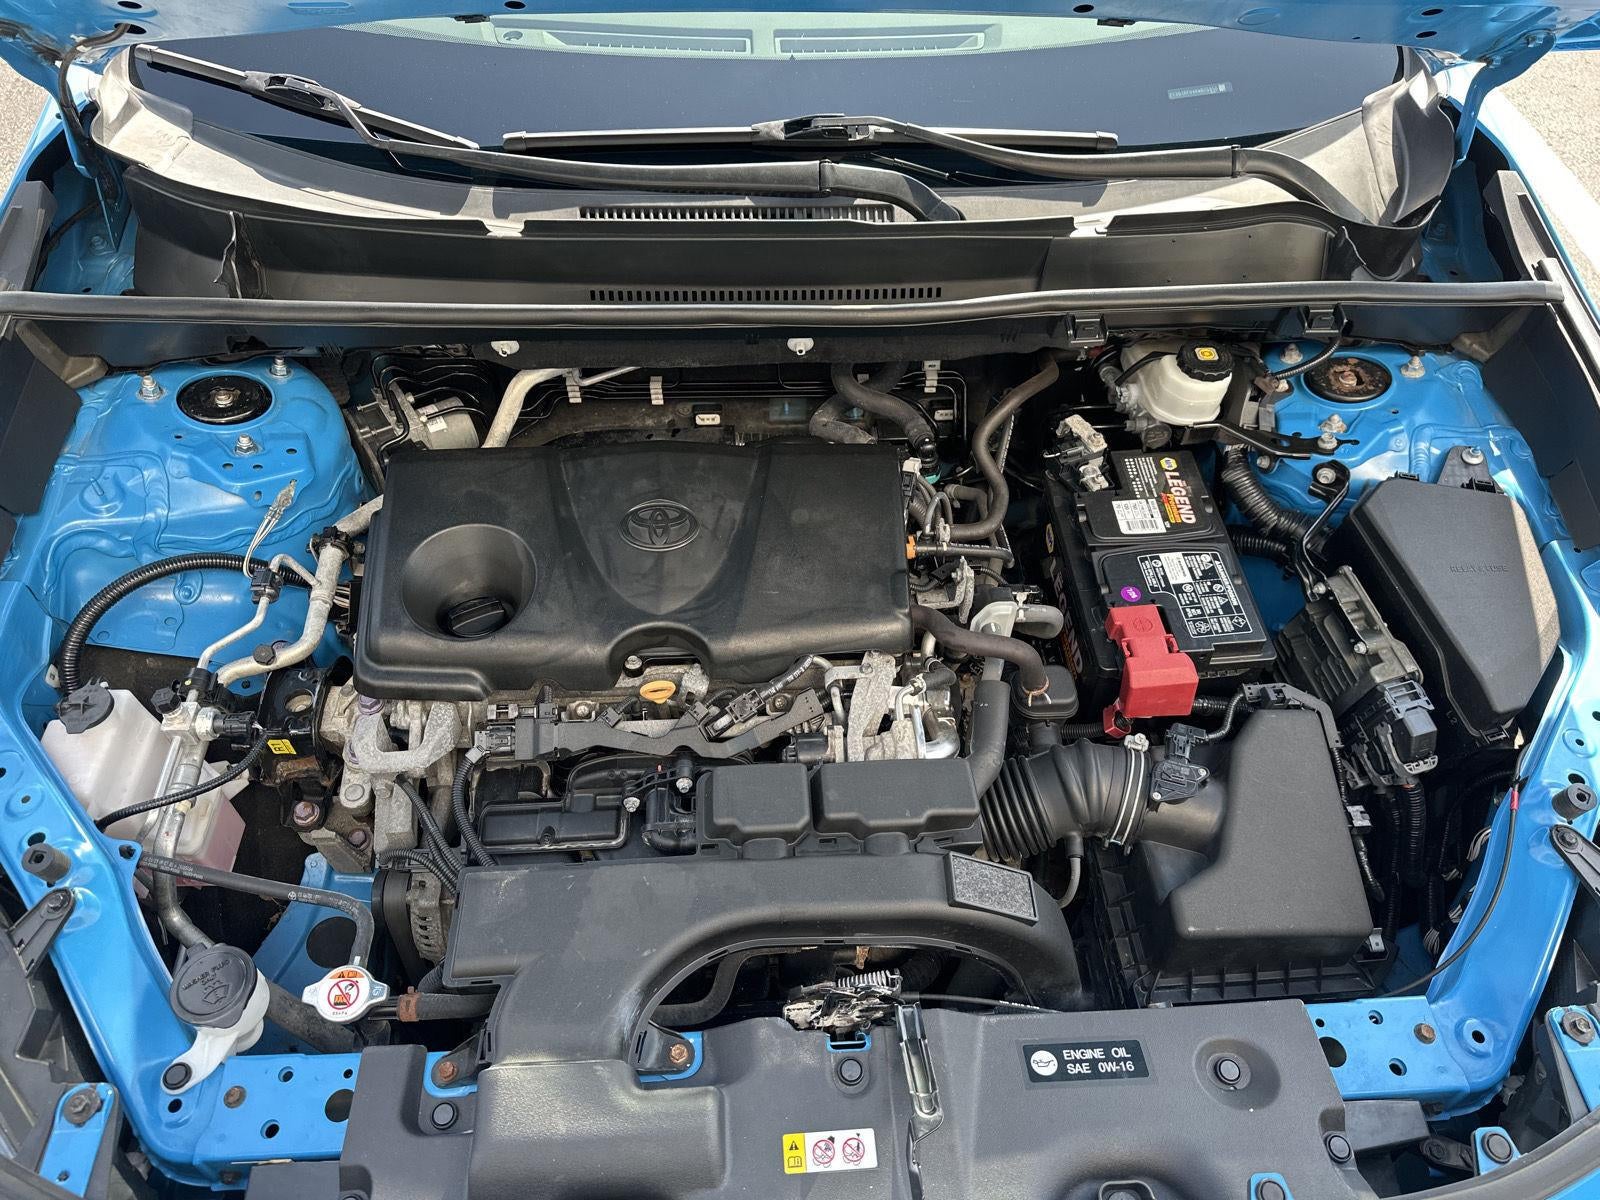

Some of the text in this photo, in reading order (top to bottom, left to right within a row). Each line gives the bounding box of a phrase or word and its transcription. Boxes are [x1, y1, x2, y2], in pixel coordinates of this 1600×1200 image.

[1165, 471, 1197, 524] LEGEND
[1062, 1046, 1132, 1060] ENGINE OIL
[1066, 1060, 1135, 1075] SAE 0W-16
